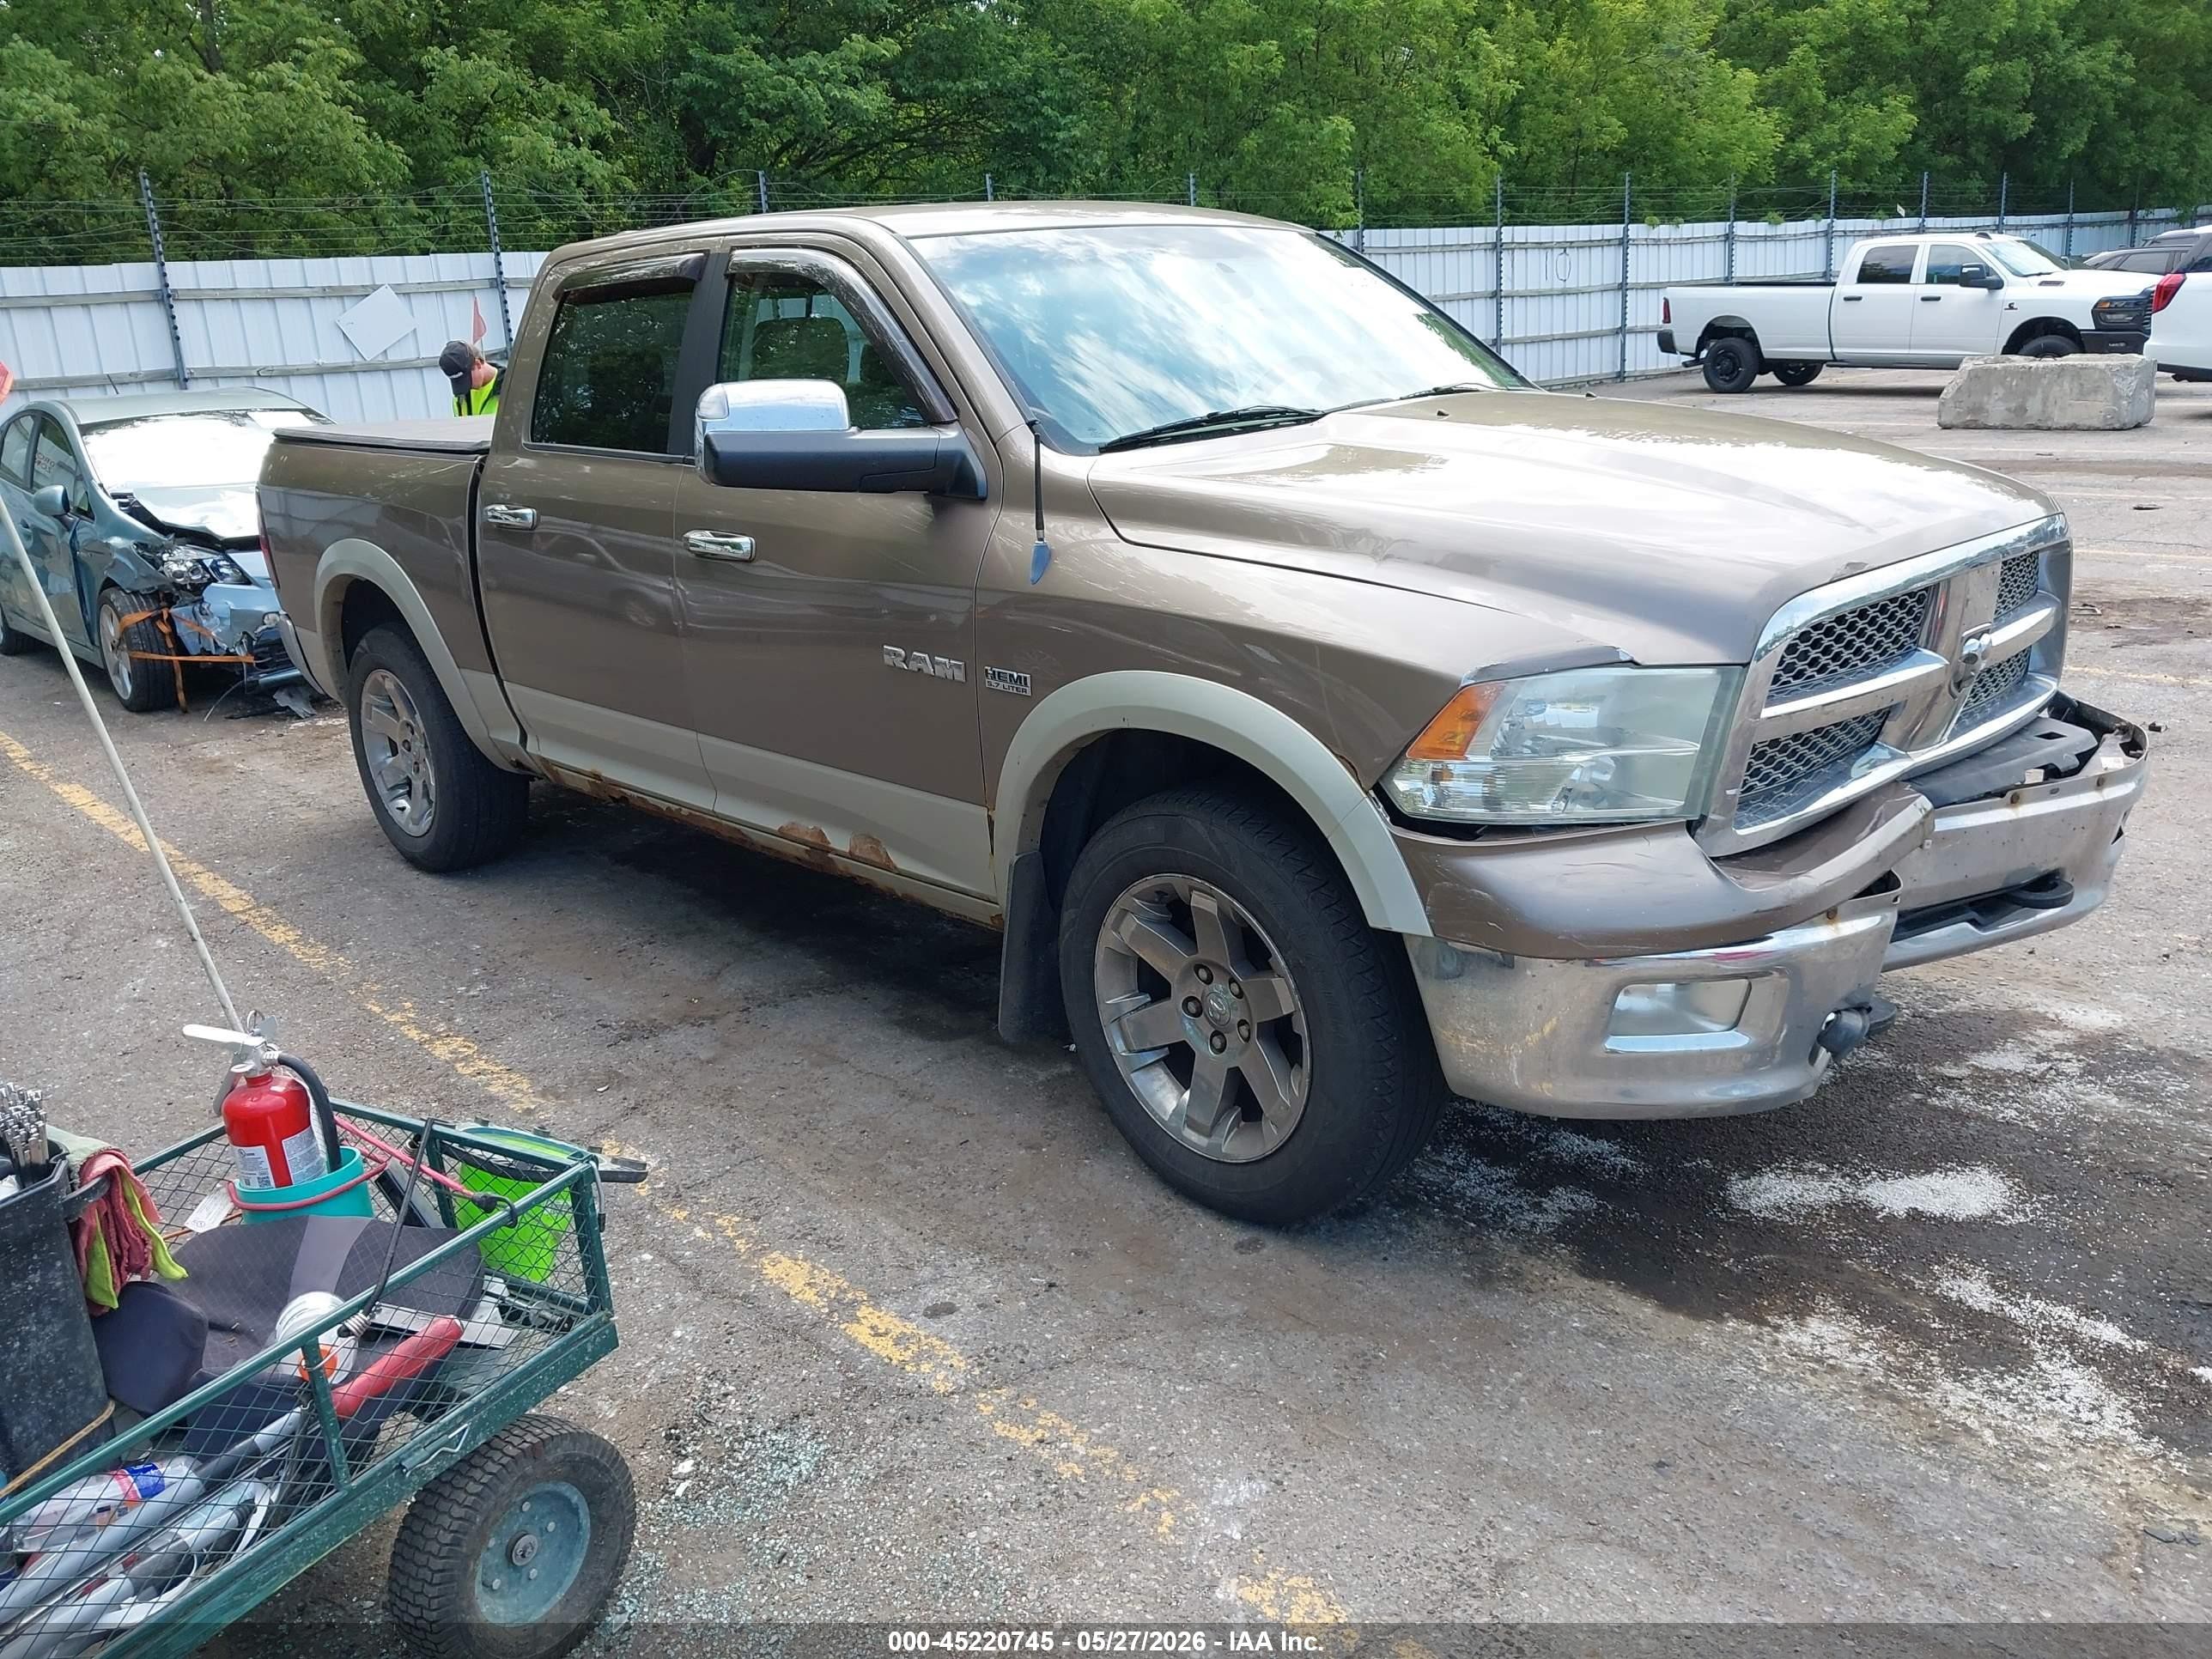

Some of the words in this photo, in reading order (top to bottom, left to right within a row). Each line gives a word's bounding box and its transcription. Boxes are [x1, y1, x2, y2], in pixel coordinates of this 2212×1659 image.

[883, 644, 966, 683] RAM
[984, 666, 1030, 686] HEMI
[1002, 683, 1028, 694] LITER
